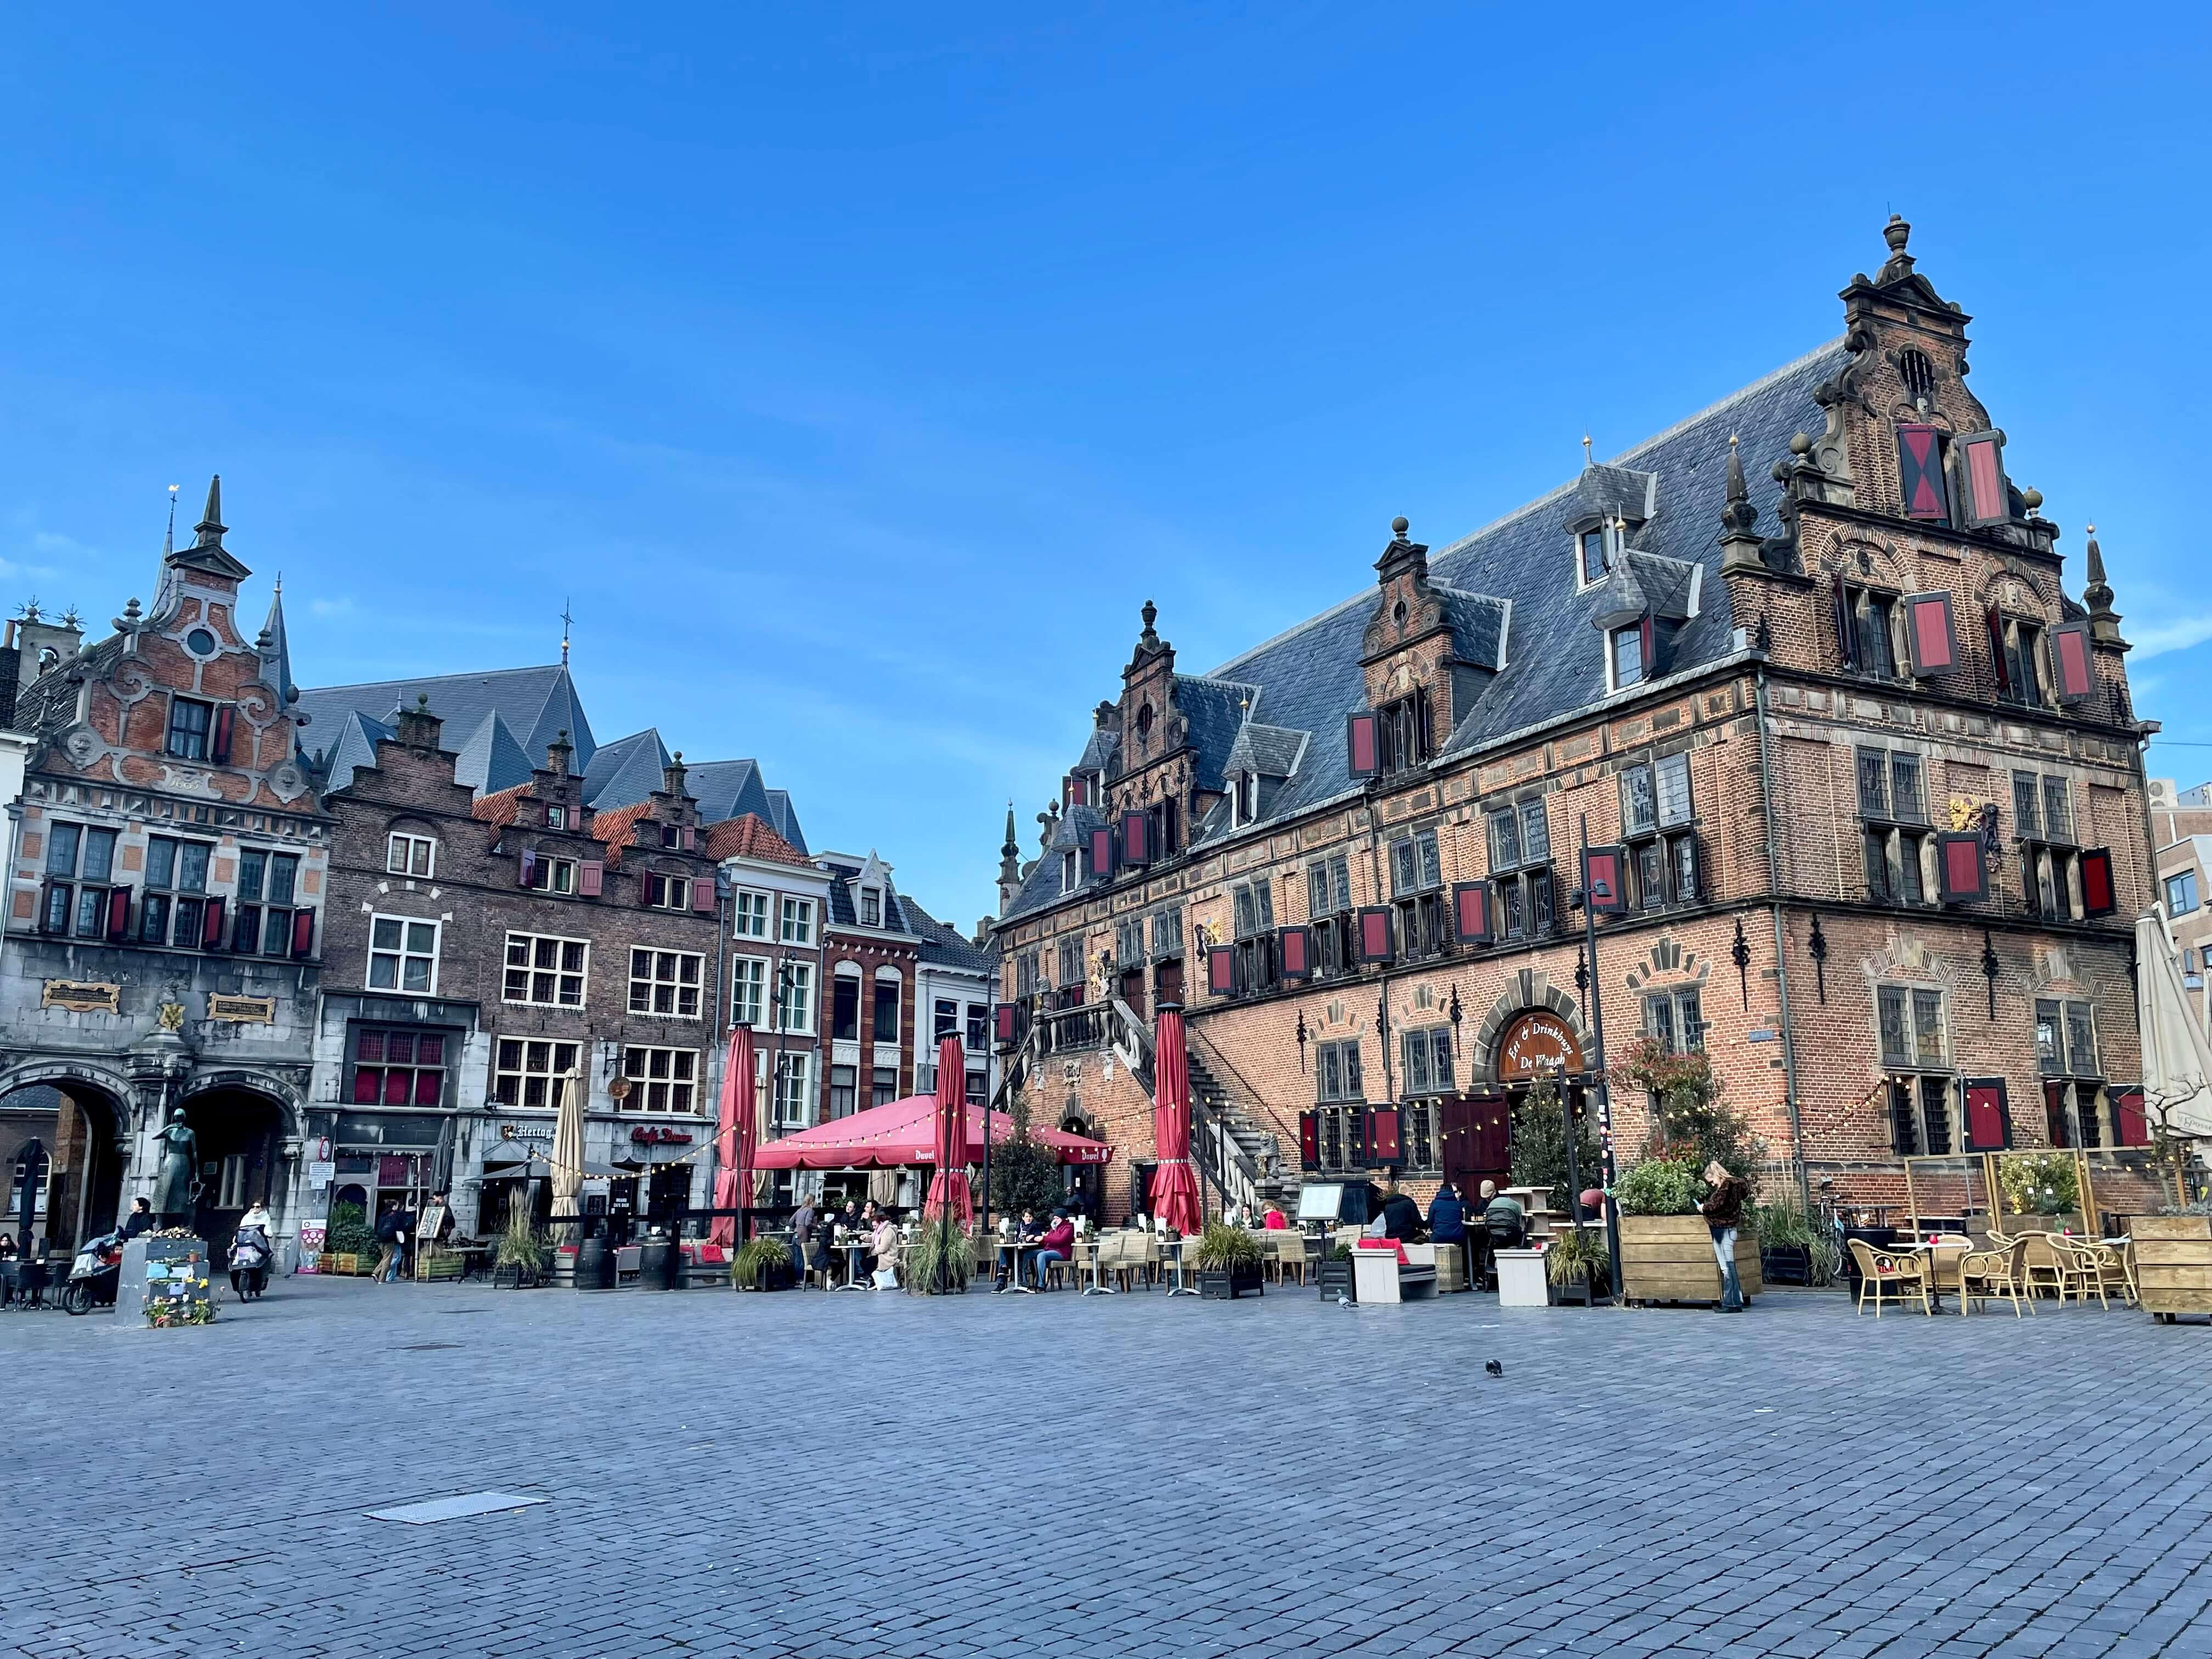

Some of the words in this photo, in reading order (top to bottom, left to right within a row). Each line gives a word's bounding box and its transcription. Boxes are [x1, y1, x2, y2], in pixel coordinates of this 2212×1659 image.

[1508, 1040, 1520, 1063] Eet
[1532, 1023, 1573, 1054] Drinkhuys
[1520, 1057, 1533, 1069] De
[1536, 1052, 1565, 1068] Waagh
[516, 1125, 552, 1139] Hertog
[915, 1149, 935, 1160] Duvel
[1082, 1152, 1099, 1160] Duvel
